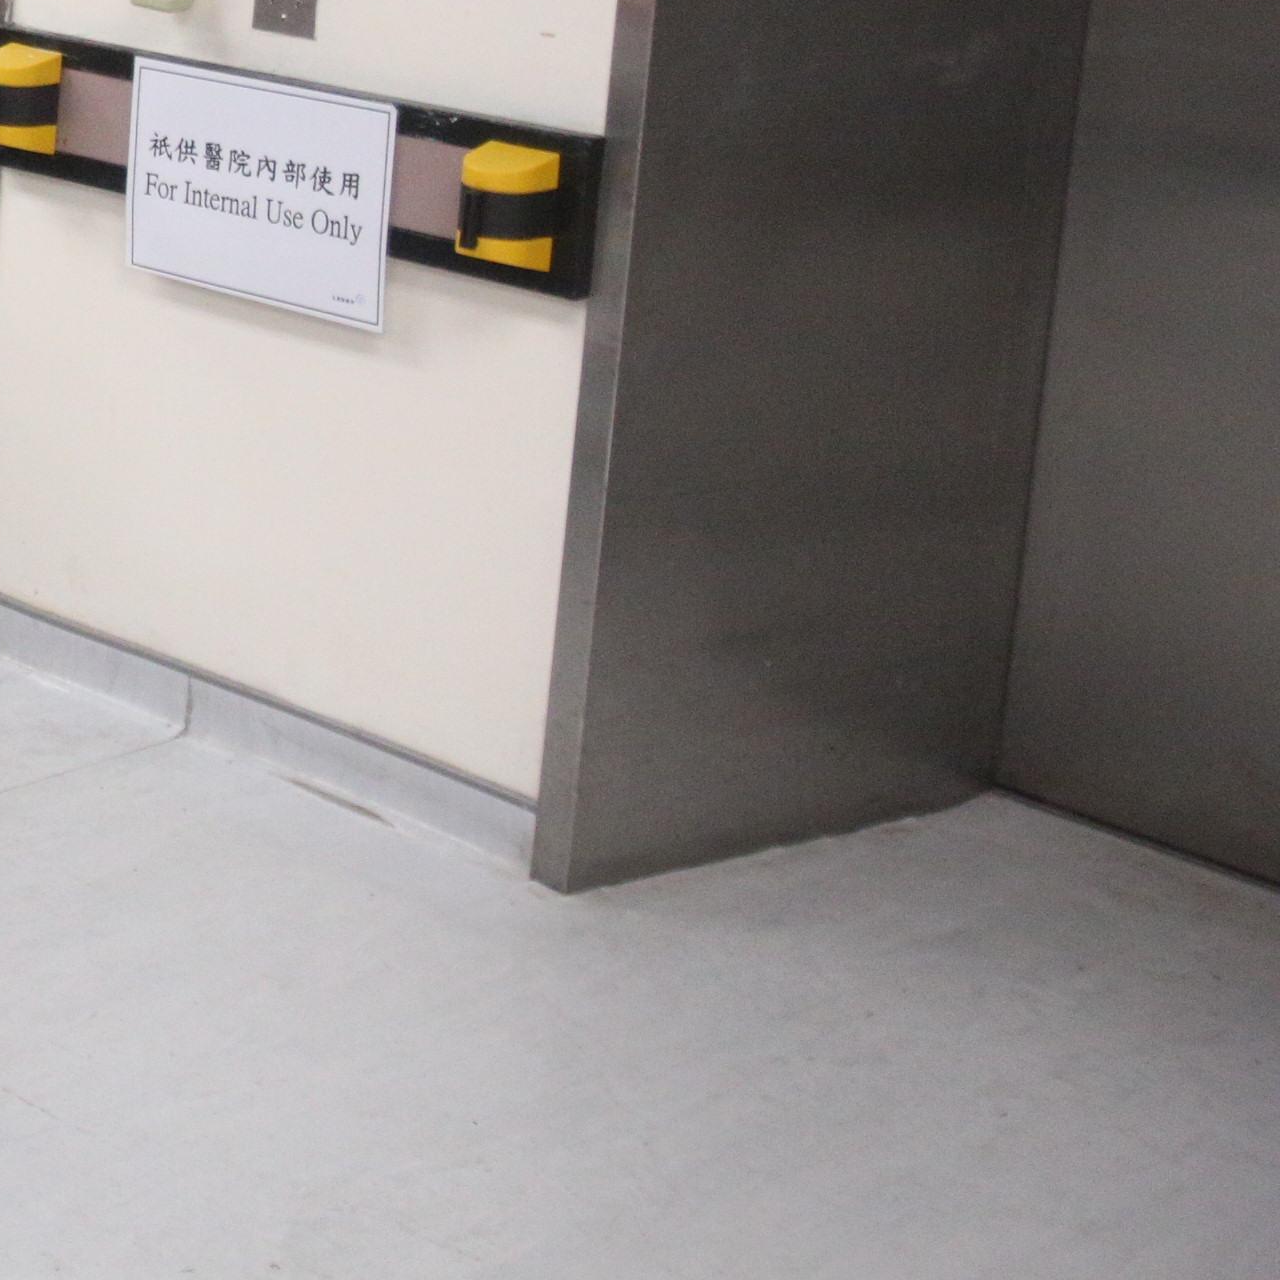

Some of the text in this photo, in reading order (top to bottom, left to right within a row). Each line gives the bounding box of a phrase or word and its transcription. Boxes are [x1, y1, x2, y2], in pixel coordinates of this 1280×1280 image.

[144, 172, 363, 246] For Internal Use Only
